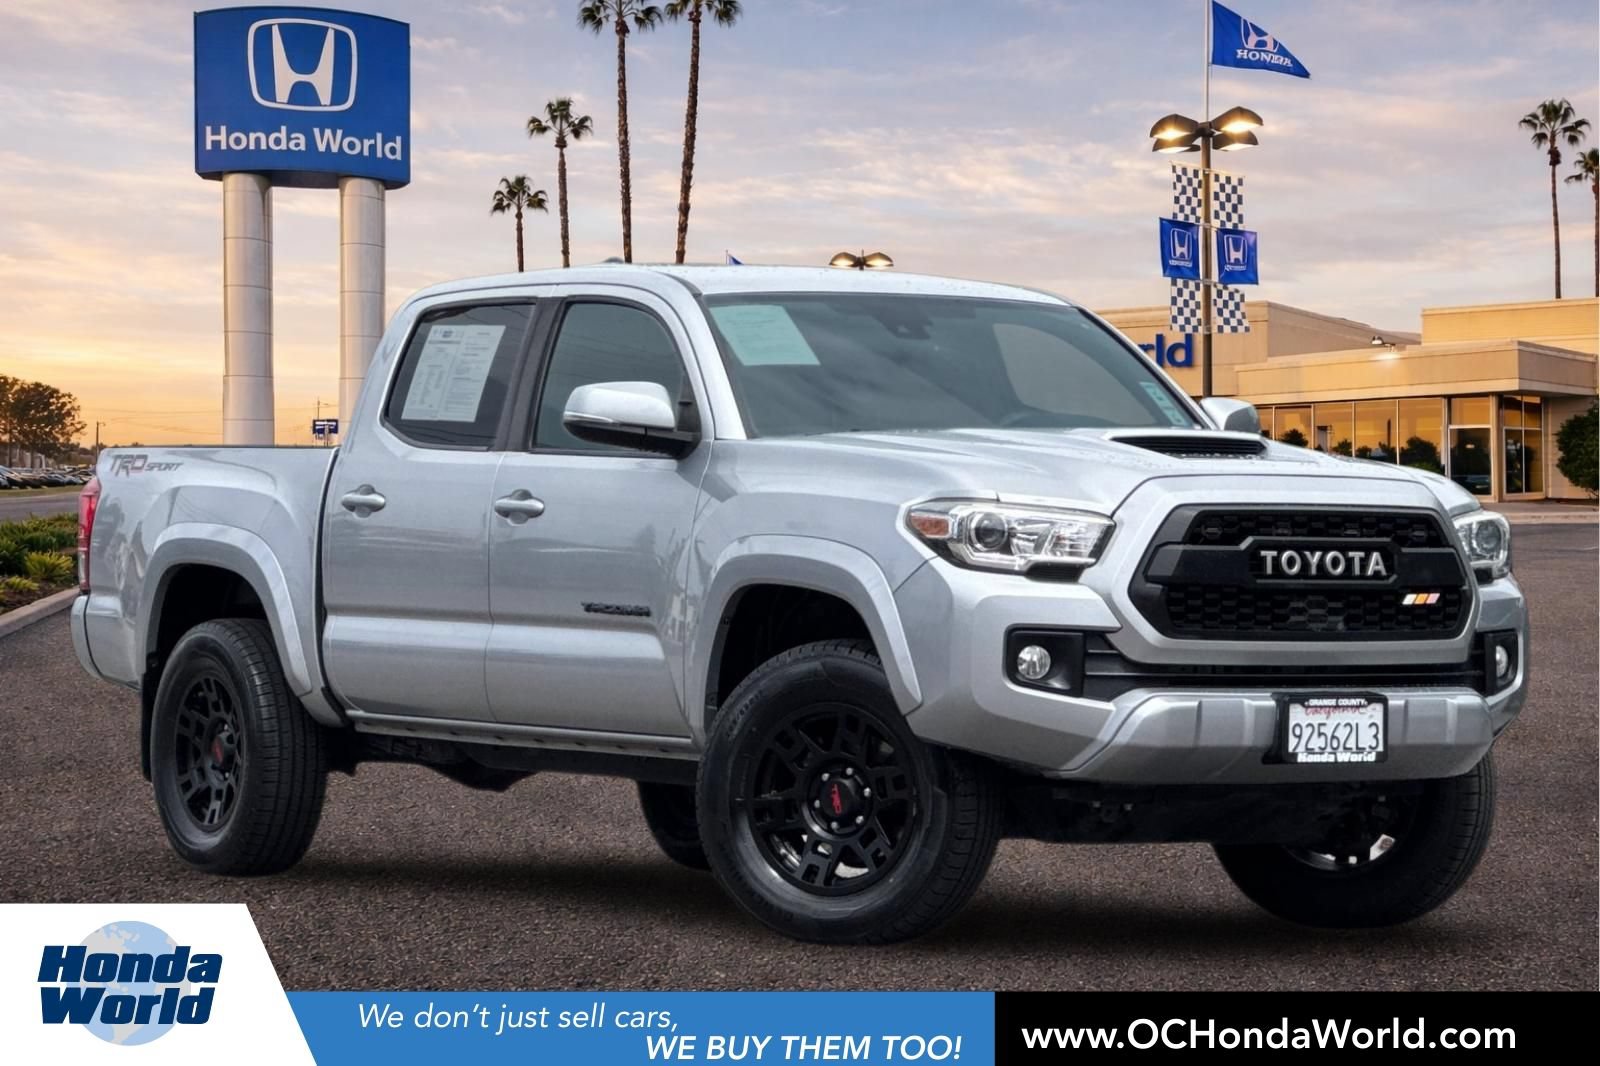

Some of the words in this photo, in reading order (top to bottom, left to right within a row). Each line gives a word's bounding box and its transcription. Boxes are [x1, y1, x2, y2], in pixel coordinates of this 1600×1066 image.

[205, 125, 306, 151] Honda
[313, 127, 402, 161] World
[110, 454, 148, 477] TRD
[145, 462, 184, 471] SPORT
[1260, 550, 1387, 576] TOYOTA
[1338, 698, 1367, 706] COUNTY
[1292, 722, 1380, 752] 92562L3
[1297, 752, 1335, 763] Honda
[1336, 752, 1377, 763] World
